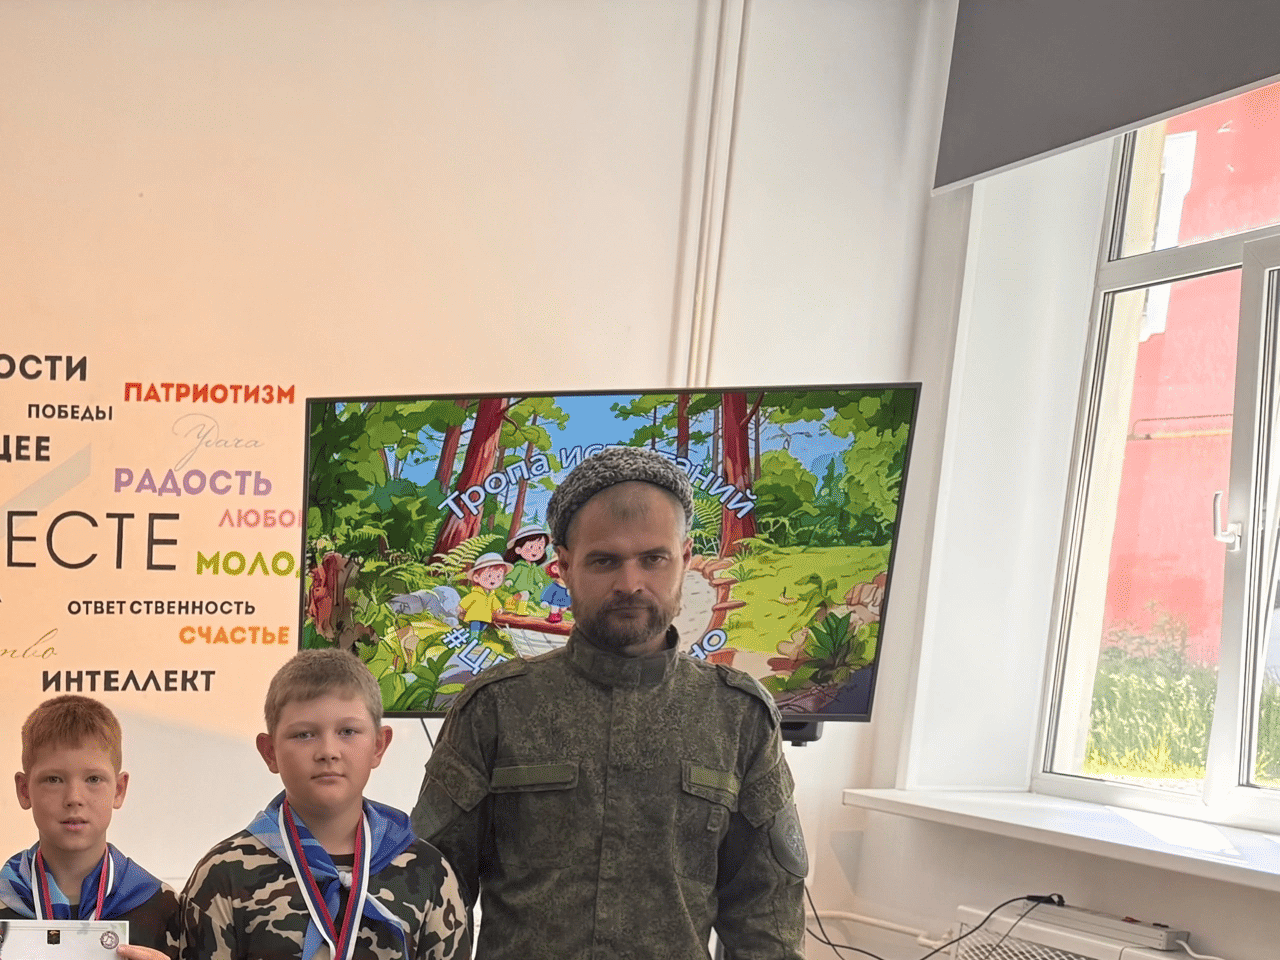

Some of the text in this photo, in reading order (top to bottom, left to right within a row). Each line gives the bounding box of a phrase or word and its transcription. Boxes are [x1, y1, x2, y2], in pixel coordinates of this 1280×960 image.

[124, 382, 295, 404] ПАТРИОТИЗМ
[28, 404, 113, 421] ПОБЕДЫ
[172, 413, 265, 472] Удача
[115, 468, 272, 496] РАДОСТЬ
[437, 453, 551, 520] Тропа
[218, 509, 302, 528] ЛЮБО
[196, 550, 300, 578] МОЛО
[179, 626, 290, 645] СЧАСТЬЕ
[42, 670, 216, 692] ИНТЕЛЛЕКТ
